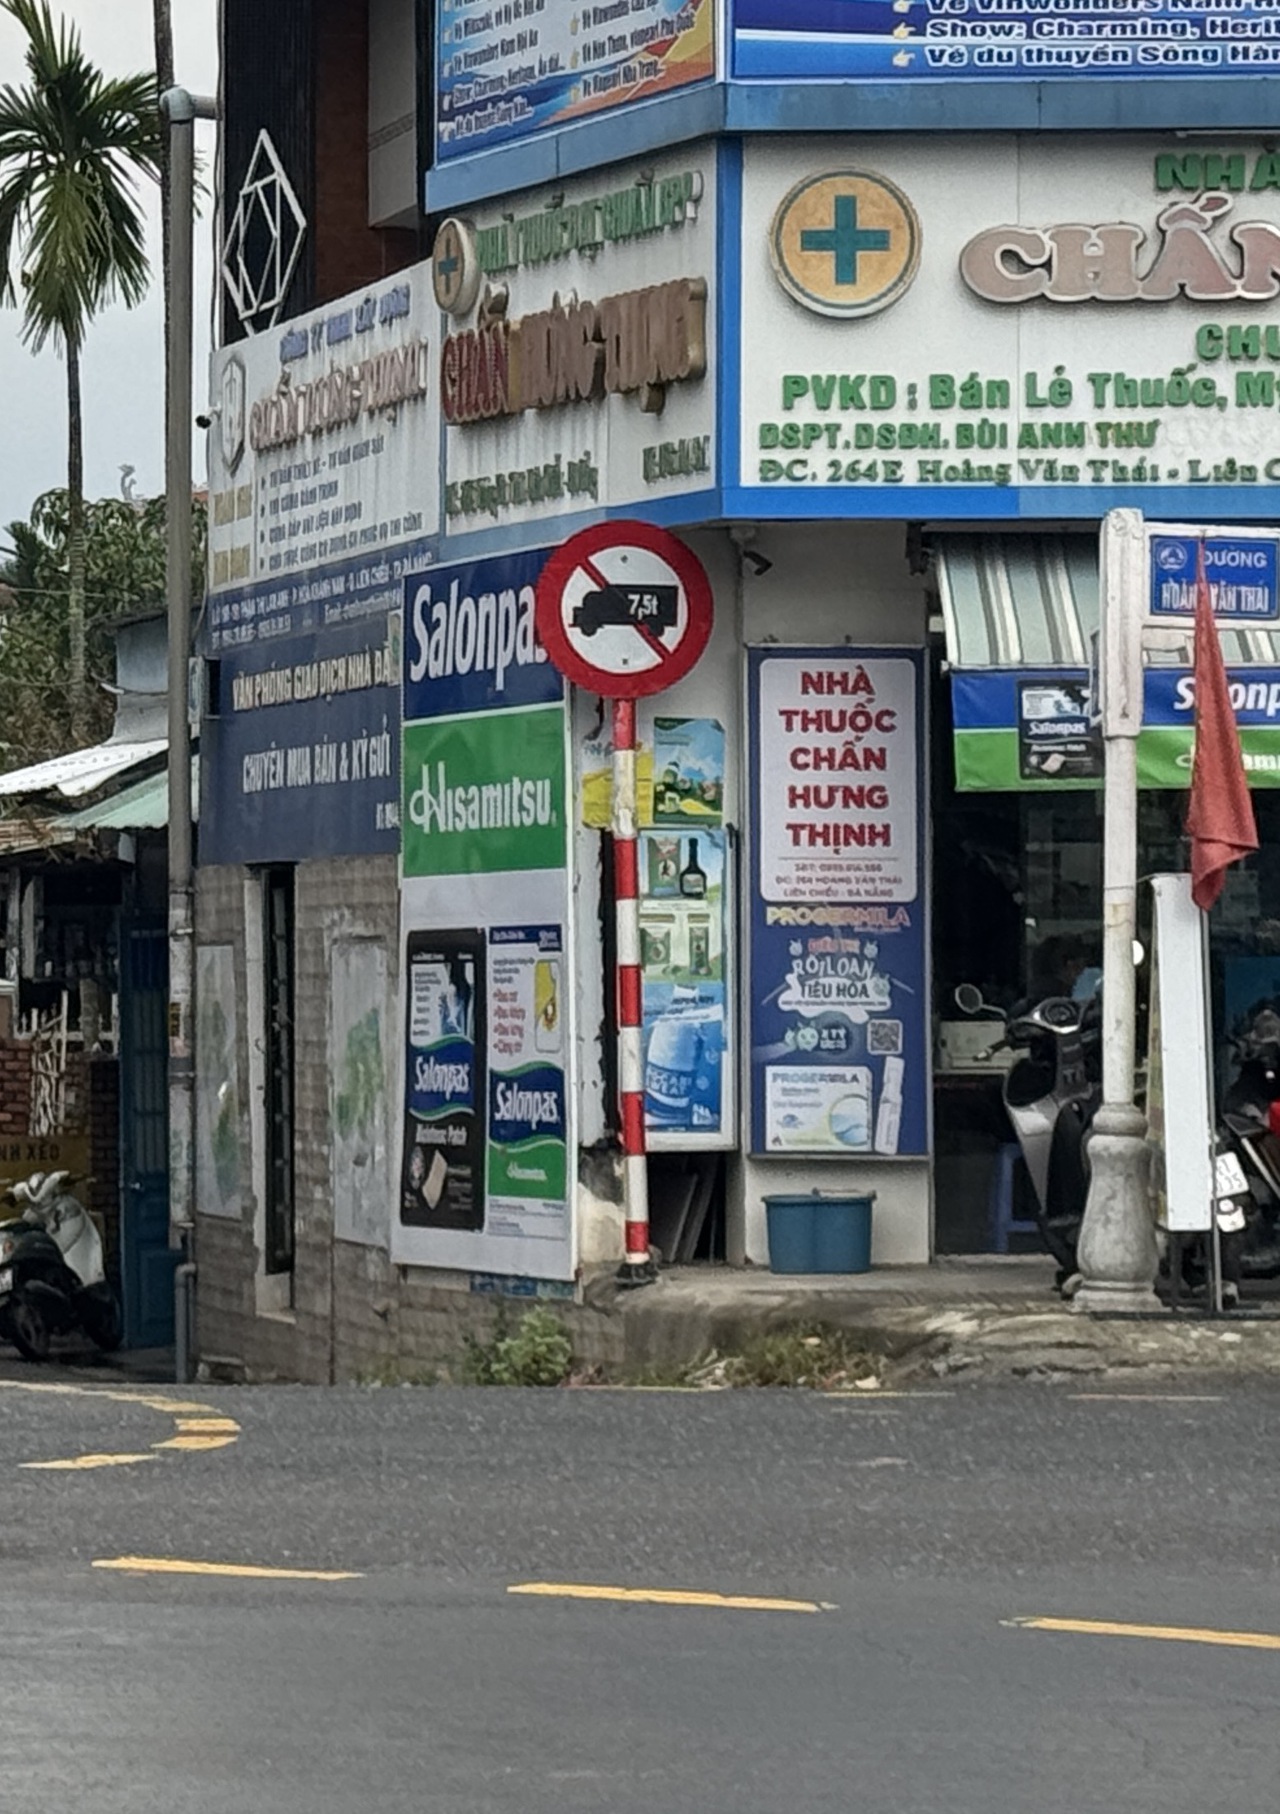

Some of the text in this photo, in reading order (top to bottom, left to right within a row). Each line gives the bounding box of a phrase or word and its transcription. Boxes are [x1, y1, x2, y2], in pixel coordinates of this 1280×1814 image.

[928, 20, 1027, 40] Show:
[1033, 18, 1200, 38] Charming,
[974, 48, 1017, 67] du
[1138, 45, 1221, 65] Sông
[929, 372, 1010, 410] Bán
[1235, 371, 1280, 413] M
[1017, 421, 1086, 449] ANH
[1162, 577, 1198, 610] HOÀN
[801, 664, 875, 695] NHÀ
[779, 697, 897, 733] THUỐC
[790, 736, 887, 771] CHẤN
[787, 785, 889, 809] HƯNG
[786, 823, 891, 855] THỊNH
[415, 1056, 470, 1100] Salonpas
[495, 1082, 558, 1131] Salonpas
